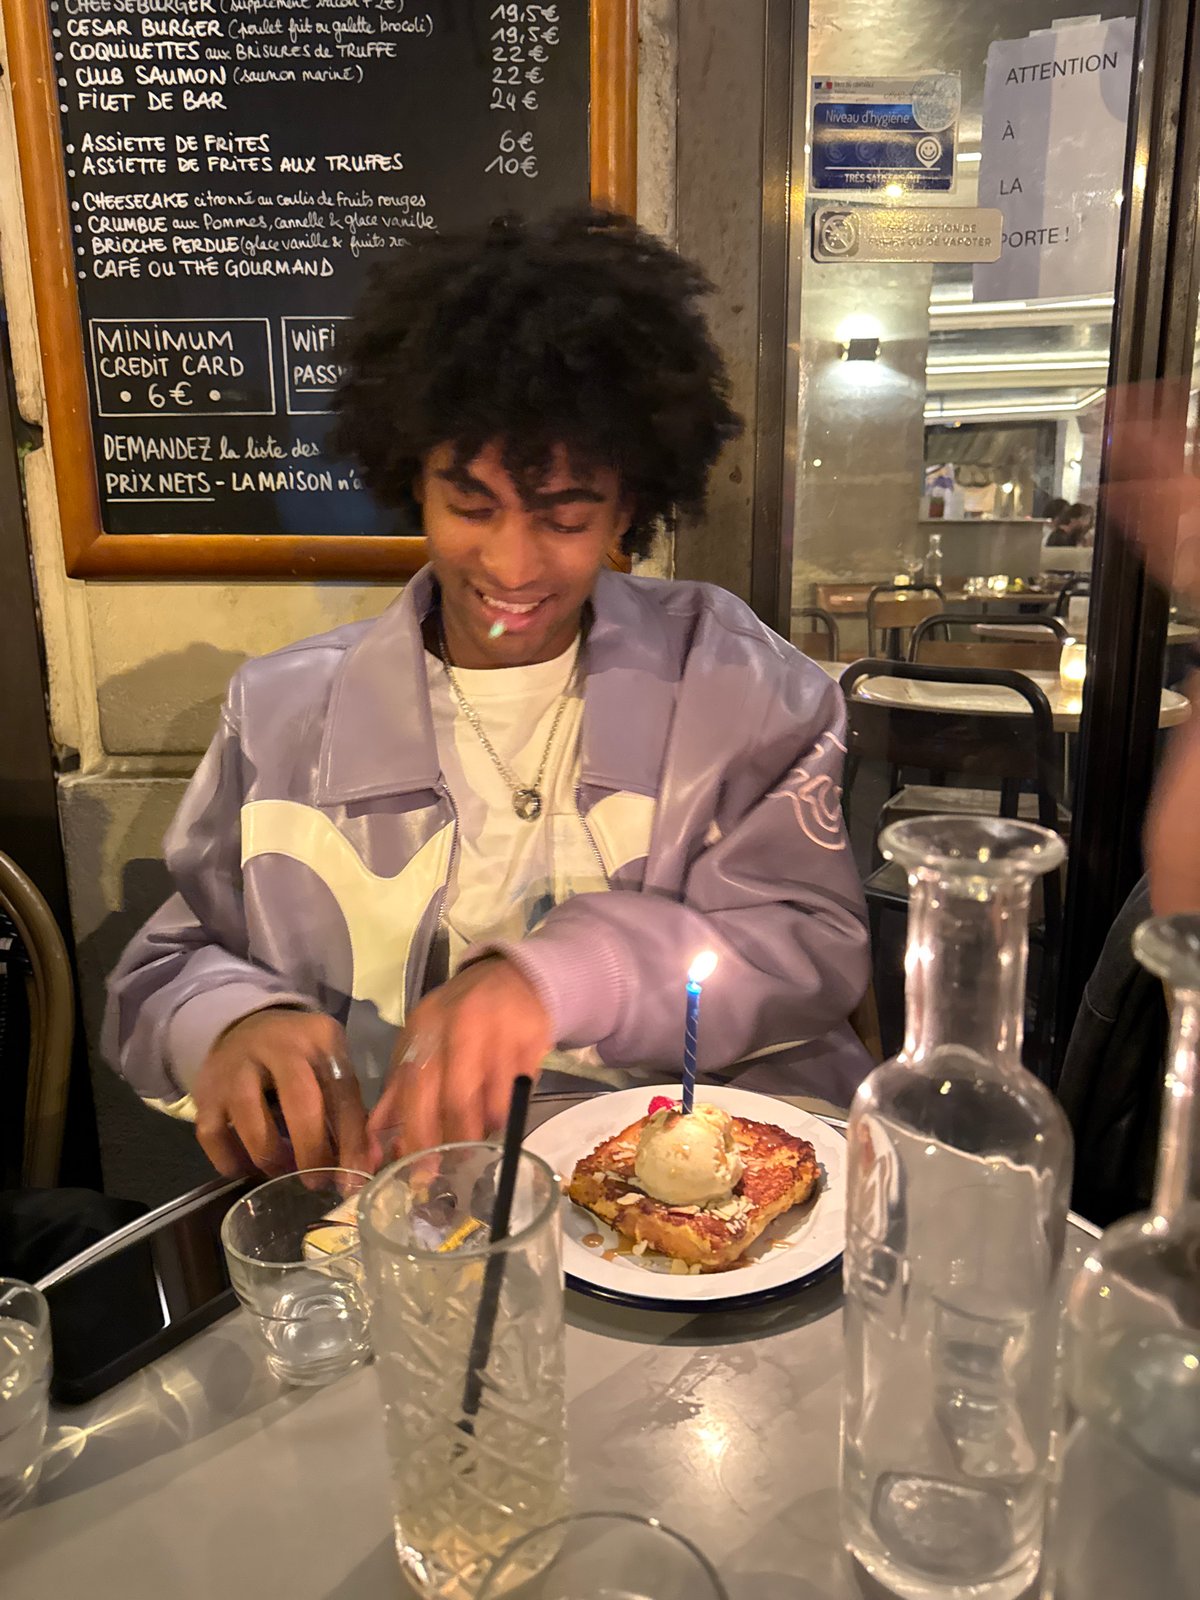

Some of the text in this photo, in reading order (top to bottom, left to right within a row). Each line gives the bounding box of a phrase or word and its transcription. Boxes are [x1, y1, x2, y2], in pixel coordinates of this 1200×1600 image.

[65, 0, 216, 15] CHEESEBURGER
[67, 15, 432, 43] CESAR BURGER (poulet frit ou galette brocoli)
[205, 48, 231, 60] aux
[314, 44, 333, 58] de
[336, 42, 396, 58] TRUFFE
[135, 65, 226, 85] SAUMON
[234, 67, 295, 84] (saumon
[303, 65, 363, 83] mariné)
[1005, 52, 1118, 85] ATTENTION
[148, 91, 173, 110] DE
[183, 90, 227, 110] BAR
[825, 110, 910, 127] Niveau d'hygiène
[1002, 121, 1015, 140] À
[81, 132, 165, 153] ASSIETTE
[176, 135, 198, 153] DE
[83, 156, 166, 175] ASSIETTE
[177, 157, 199, 172] DE
[280, 157, 316, 173] AUX
[325, 153, 403, 172] TRUFFES
[844, 172, 865, 183] TRÈS
[1000, 178, 1023, 195] LA
[83, 192, 189, 211] CHEESECAKE
[194, 190, 255, 207] citronné
[258, 196, 273, 205] au
[317, 191, 334, 206] de
[378, 195, 425, 216] rouges
[88, 216, 167, 234] CRUMBLE
[173, 219, 199, 229] aux
[275, 212, 325, 229] cannelle
[329, 213, 344, 229] &
[345, 212, 377, 234] glace
[382, 209, 437, 229] vanille
[92, 236, 167, 255] BRIOCHE
[173, 236, 239, 254] PERDUE
[281, 232, 330, 250] vanille
[332, 236, 342, 248] &
[350, 233, 385, 257] fruits
[1064, 226, 1070, 243] !
[94, 257, 333, 278] CAFÉ OU THÉ GOURMAND
[98, 324, 233, 353] MINIMUM
[100, 354, 244, 378] CREDIT CARD
[149, 382, 192, 408] 6€
[104, 434, 319, 462] DEMANDEZ la liste des
[106, 469, 155, 493] PRIX
[159, 472, 210, 494] NETS
[232, 473, 255, 491] LA
